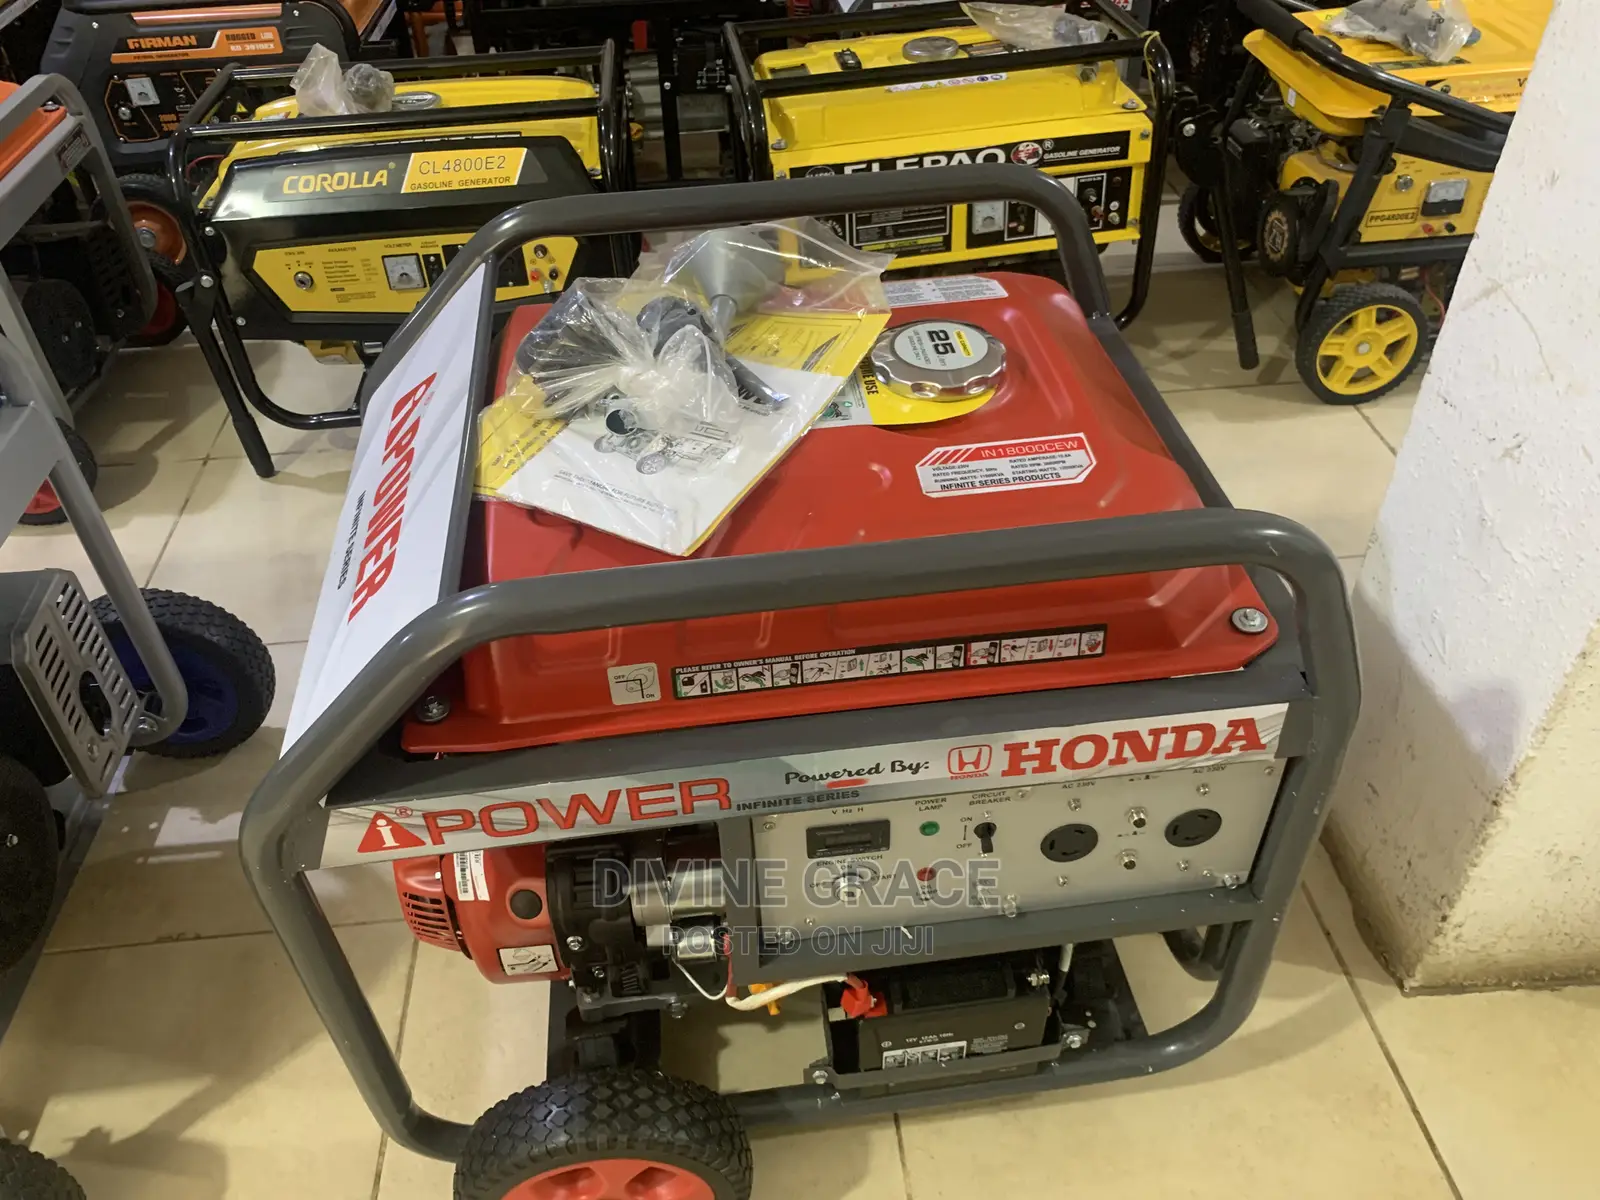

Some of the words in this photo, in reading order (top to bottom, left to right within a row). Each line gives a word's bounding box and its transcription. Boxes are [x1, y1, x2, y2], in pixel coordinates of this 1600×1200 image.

[126, 35, 198, 49] FIRMAN
[1044, 152, 1078, 160] GASOLINE
[1079, 146, 1121, 156] GENERATOR
[418, 155, 506, 176] CL4800E2
[282, 169, 388, 195] COROLLA
[410, 180, 453, 192] GASOLINE
[458, 176, 511, 188] GENERATOR
[926, 330, 956, 355] 25
[864, 380, 879, 396] USE
[980, 440, 1079, 458] IN18000CEW
[940, 480, 976, 490] INFINITE
[978, 477, 1010, 486] SERIES
[1012, 472, 1062, 483] PRODUCTS
[348, 490, 366, 544] INFINITE
[337, 541, 355, 590] SERIES
[676, 666, 700, 674] PLEASE
[701, 664, 722, 672] REFER
[734, 658, 764, 667] OWNER'S
[765, 656, 792, 664] MANUAL
[794, 652, 818, 660] BEFORE
[820, 649, 856, 658] OPERATION
[785, 762, 886, 785] Powered
[890, 759, 930, 775] By:
[1001, 717, 1266, 778] HONDA
[950, 772, 990, 780] HONDA
[968, 796, 1012, 806] BREAKER
[972, 790, 1006, 800] CIRCUIT
[422, 776, 732, 846] POWER
[736, 796, 802, 812] INFINITE
[806, 790, 860, 804] SERIES
[918, 804, 944, 812] LAMP
[851, 854, 883, 863] SWITCH
